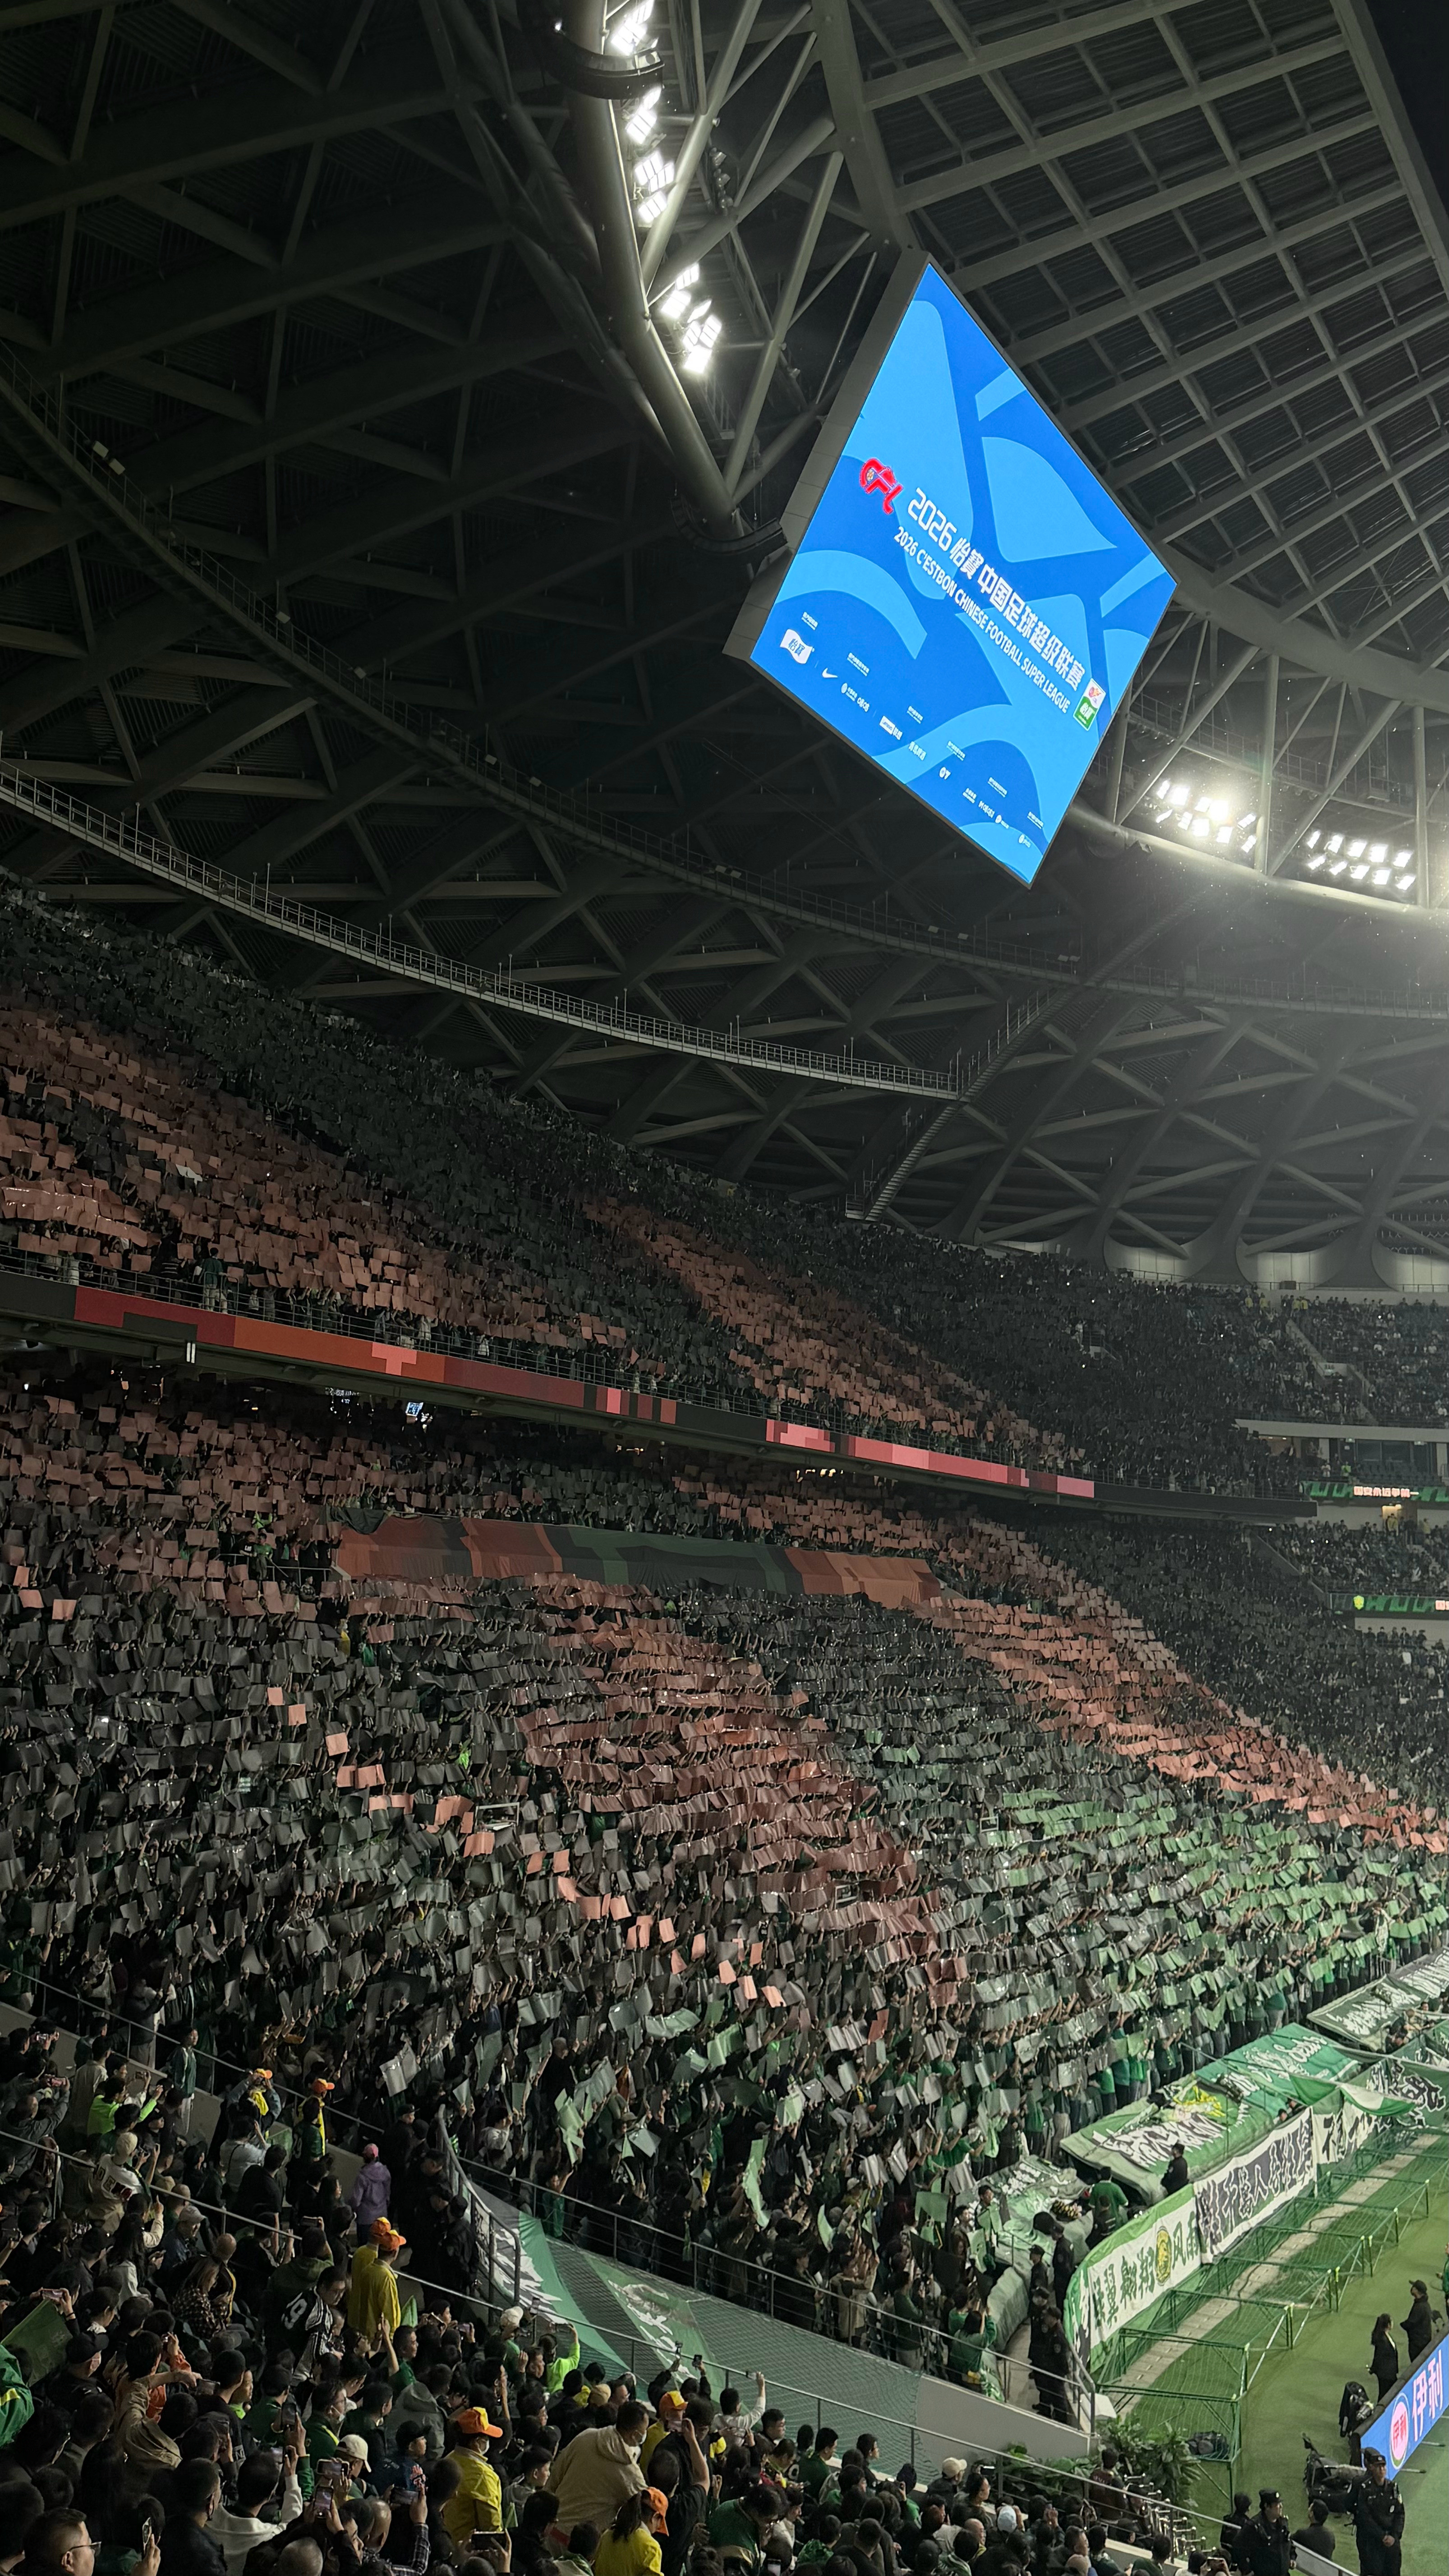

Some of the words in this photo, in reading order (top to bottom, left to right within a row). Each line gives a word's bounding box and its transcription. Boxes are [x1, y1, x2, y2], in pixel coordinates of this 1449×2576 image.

[894, 527, 918, 556] 2026
[917, 550, 957, 597] C'ESTBON
[955, 589, 988, 629] CHINESE
[985, 621, 1022, 666] FOOTBALL
[1021, 658, 1045, 688] SUPER
[1043, 680, 1070, 713] LEAGUE
[908, 488, 957, 551] 2026
[950, 538, 984, 579] 怡寶
[979, 566, 1085, 690] 中国足球超级联赛
[1412, 2349, 1443, 2442] 伊利
